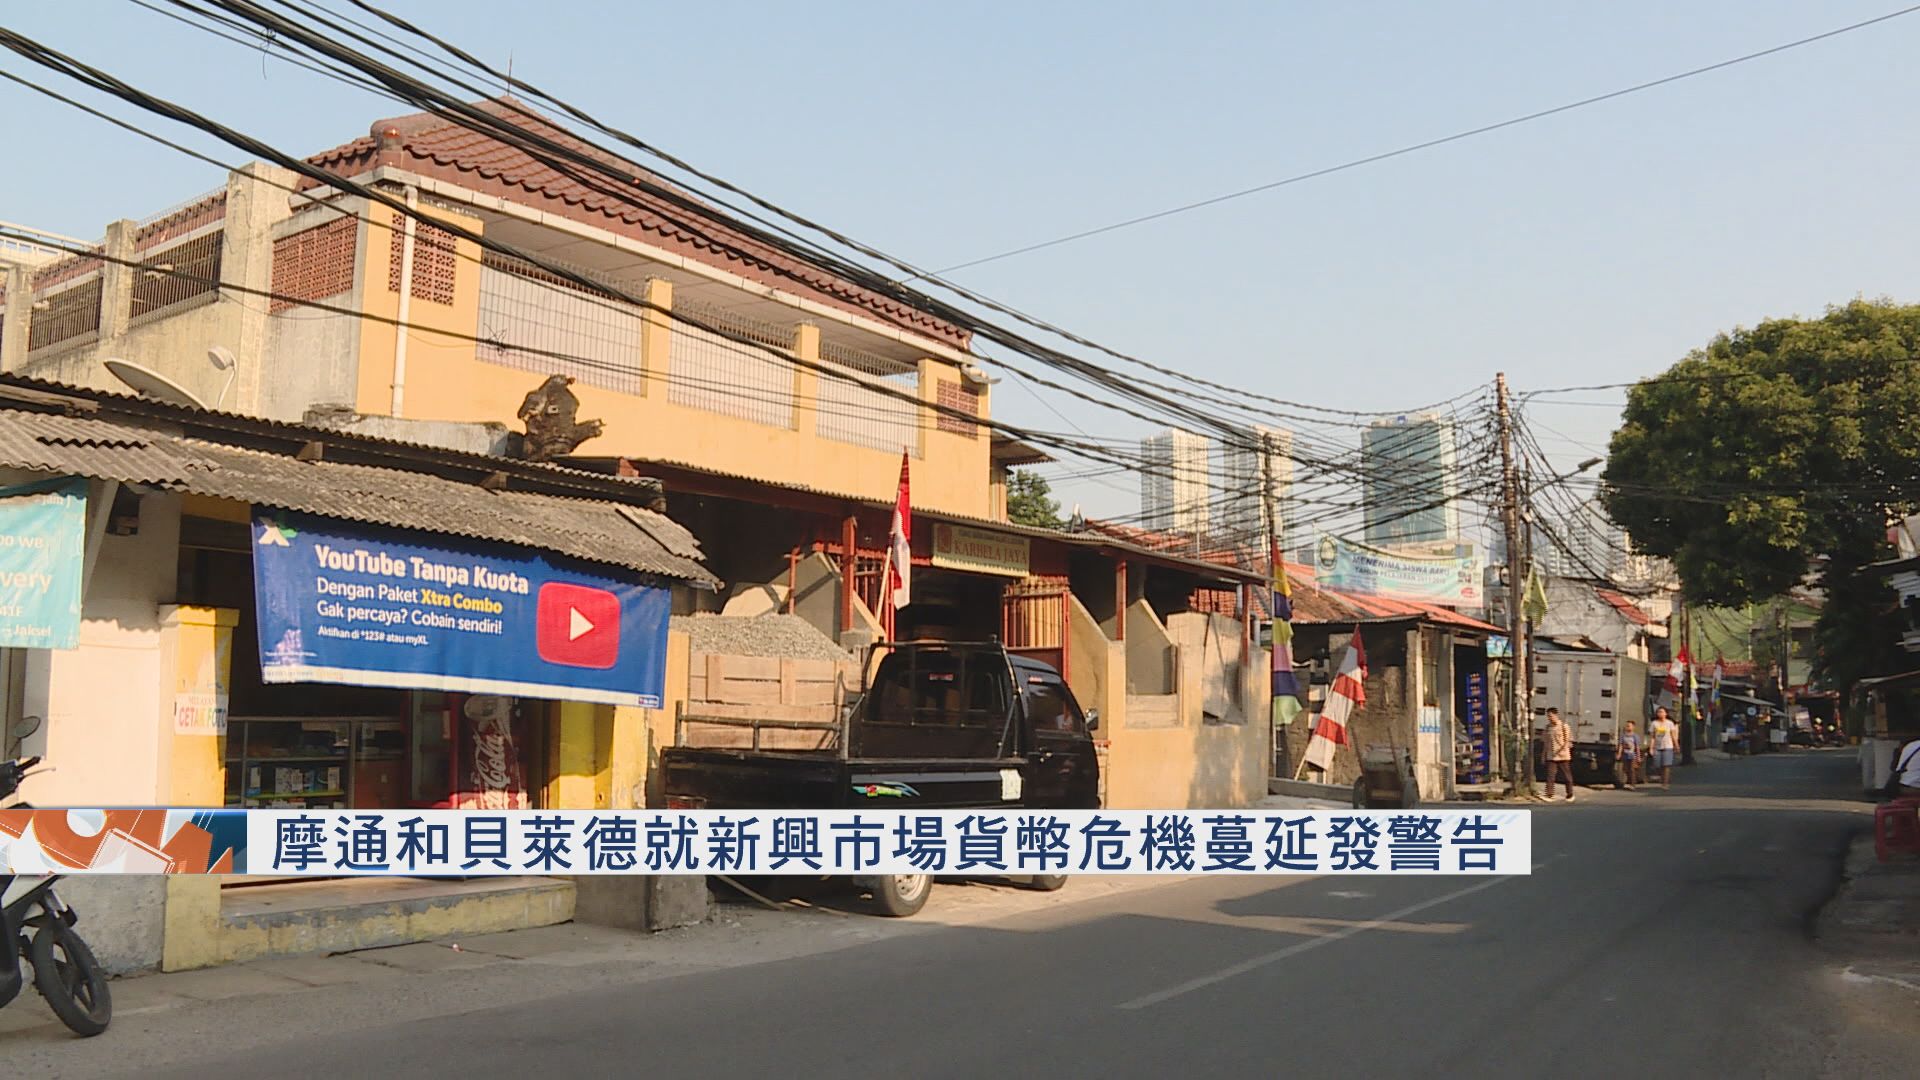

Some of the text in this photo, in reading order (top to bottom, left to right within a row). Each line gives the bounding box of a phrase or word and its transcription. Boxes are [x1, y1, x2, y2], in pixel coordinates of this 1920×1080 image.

[315, 543, 529, 595] YouTube Tanpa Kuota
[317, 576, 503, 614] Dengan Paket Xtra Combo
[317, 600, 502, 636] Gak percaya? Cobain sendiri!
[318, 625, 351, 640] Aktifkan
[352, 628, 360, 640] di
[386, 633, 405, 644] atau
[406, 635, 429, 647] myXL
